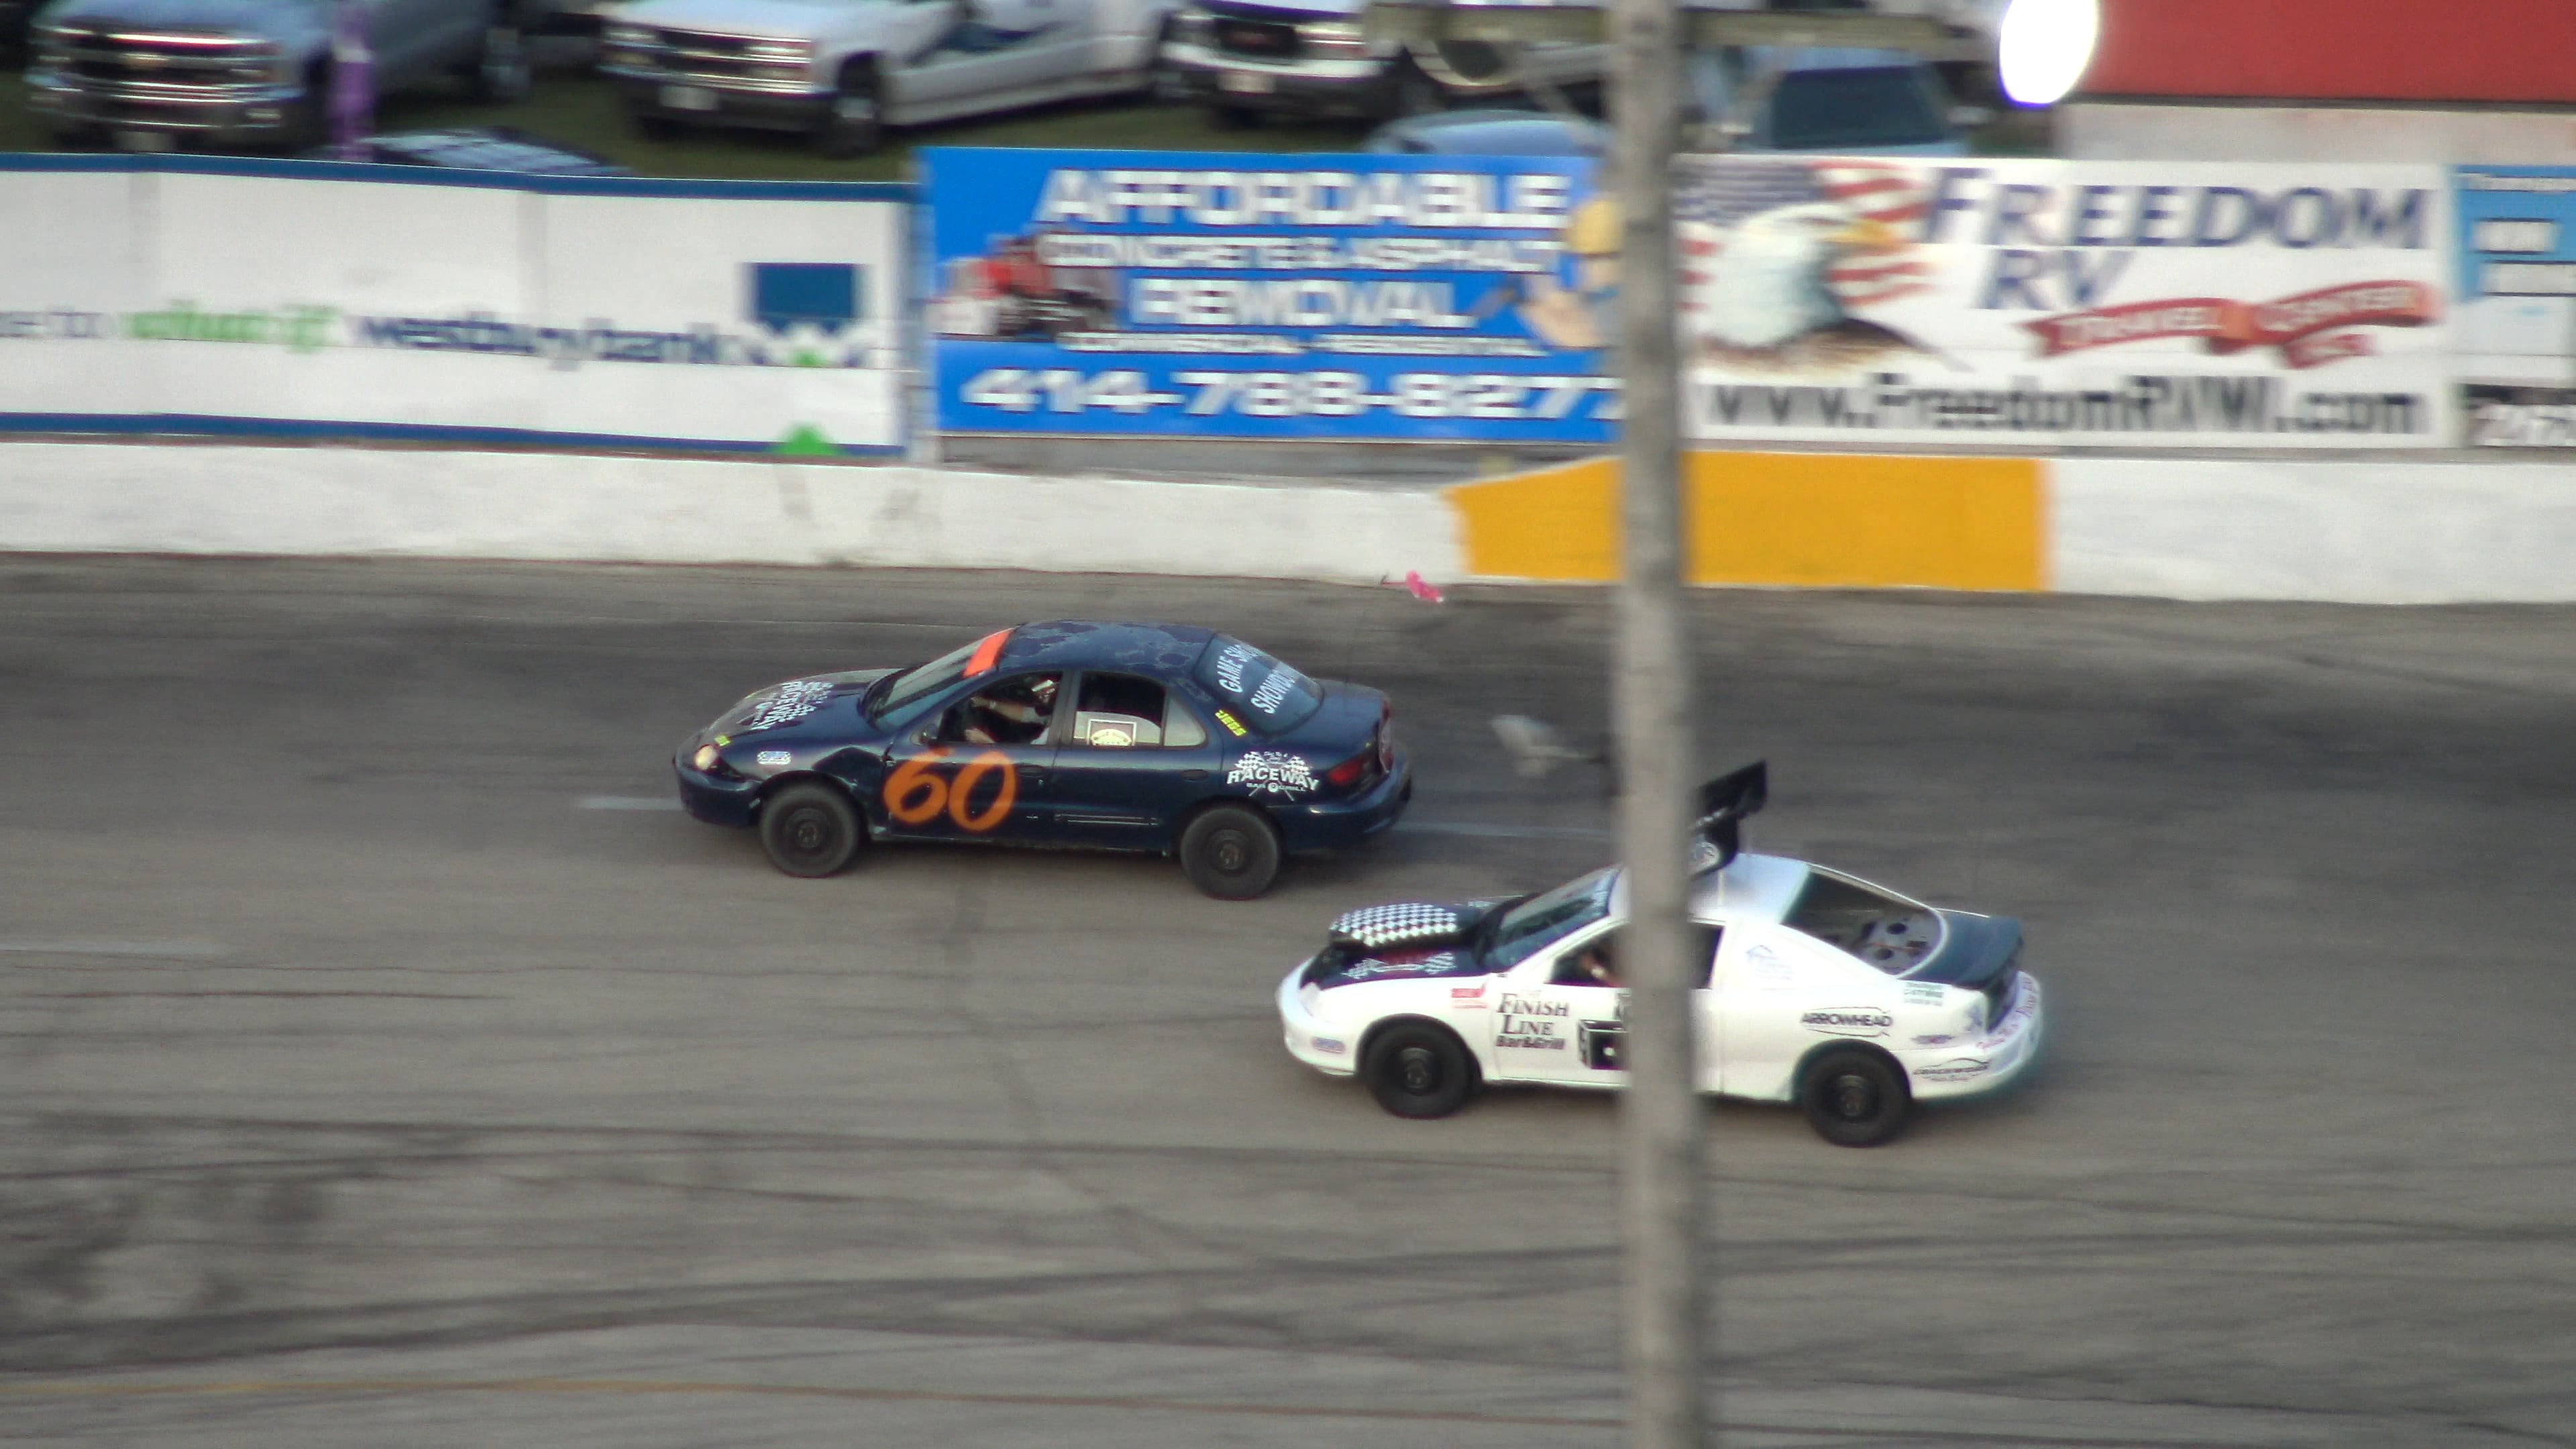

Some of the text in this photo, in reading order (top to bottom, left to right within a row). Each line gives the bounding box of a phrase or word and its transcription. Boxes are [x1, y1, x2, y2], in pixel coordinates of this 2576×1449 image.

[1038, 169, 1567, 228] AFFORDABLE
[1929, 167, 2428, 247] FREEDOM
[1138, 278, 1469, 328] REMOVAL
[1974, 249, 2135, 309] RV
[883, 749, 1016, 831] 60
[1227, 767, 1320, 791] RACEWAY
[1497, 992, 1570, 1016] FINISH
[1503, 1014, 1554, 1036] LINE
[1801, 1012, 1893, 1026] ARROWHEAD
